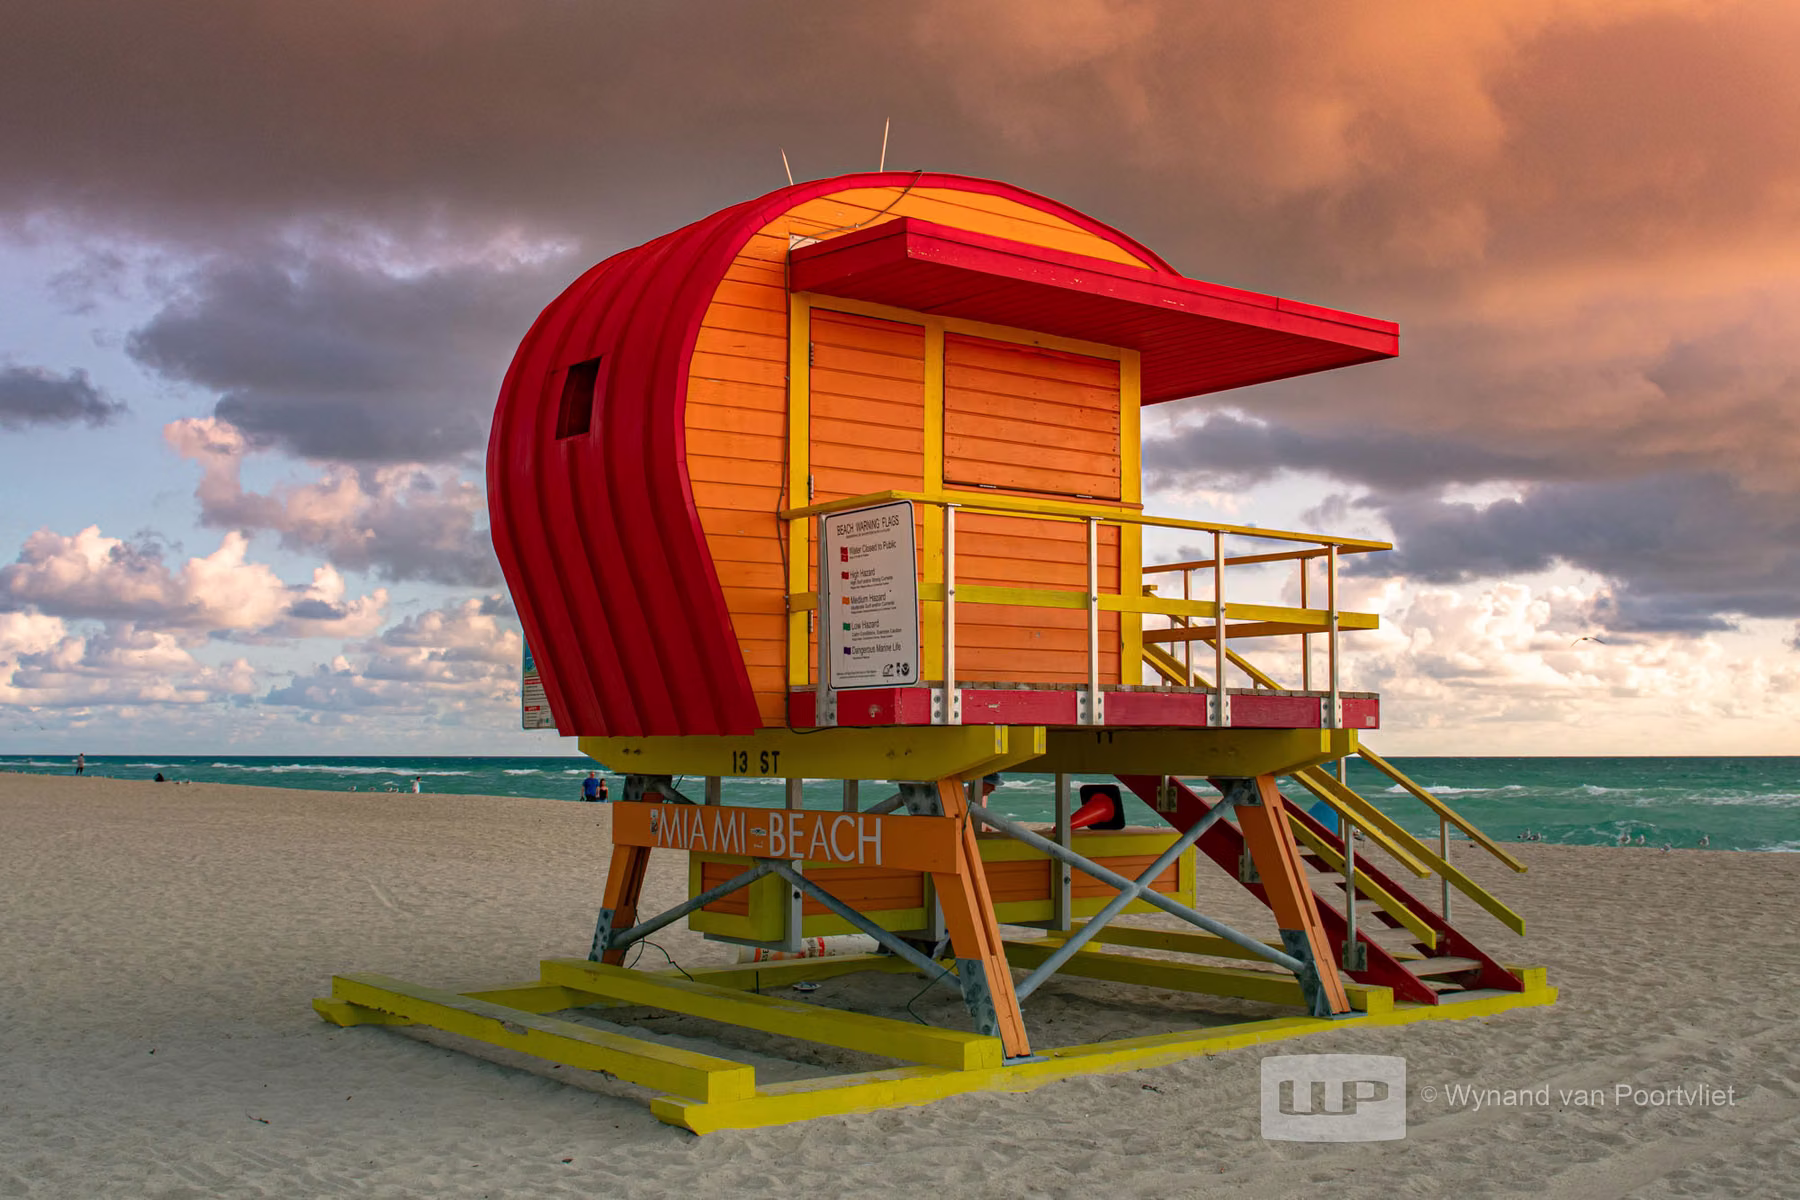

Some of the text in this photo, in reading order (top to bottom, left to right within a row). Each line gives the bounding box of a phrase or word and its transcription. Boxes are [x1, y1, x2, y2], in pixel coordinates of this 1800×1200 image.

[837, 523, 854, 536] BEACH
[856, 519, 880, 532] WARNING
[882, 515, 899, 528] FLAGS
[849, 540, 897, 554] Water Closed to Public
[850, 568, 875, 581] High Hazard
[851, 593, 886, 604] Medium Hazard
[862, 620, 879, 629] Hazard
[852, 641, 901, 656] Dangerous Marine Life
[733, 751, 780, 774] 13 ST
[658, 806, 746, 854] MIAMI
[769, 811, 882, 865] BEACH
